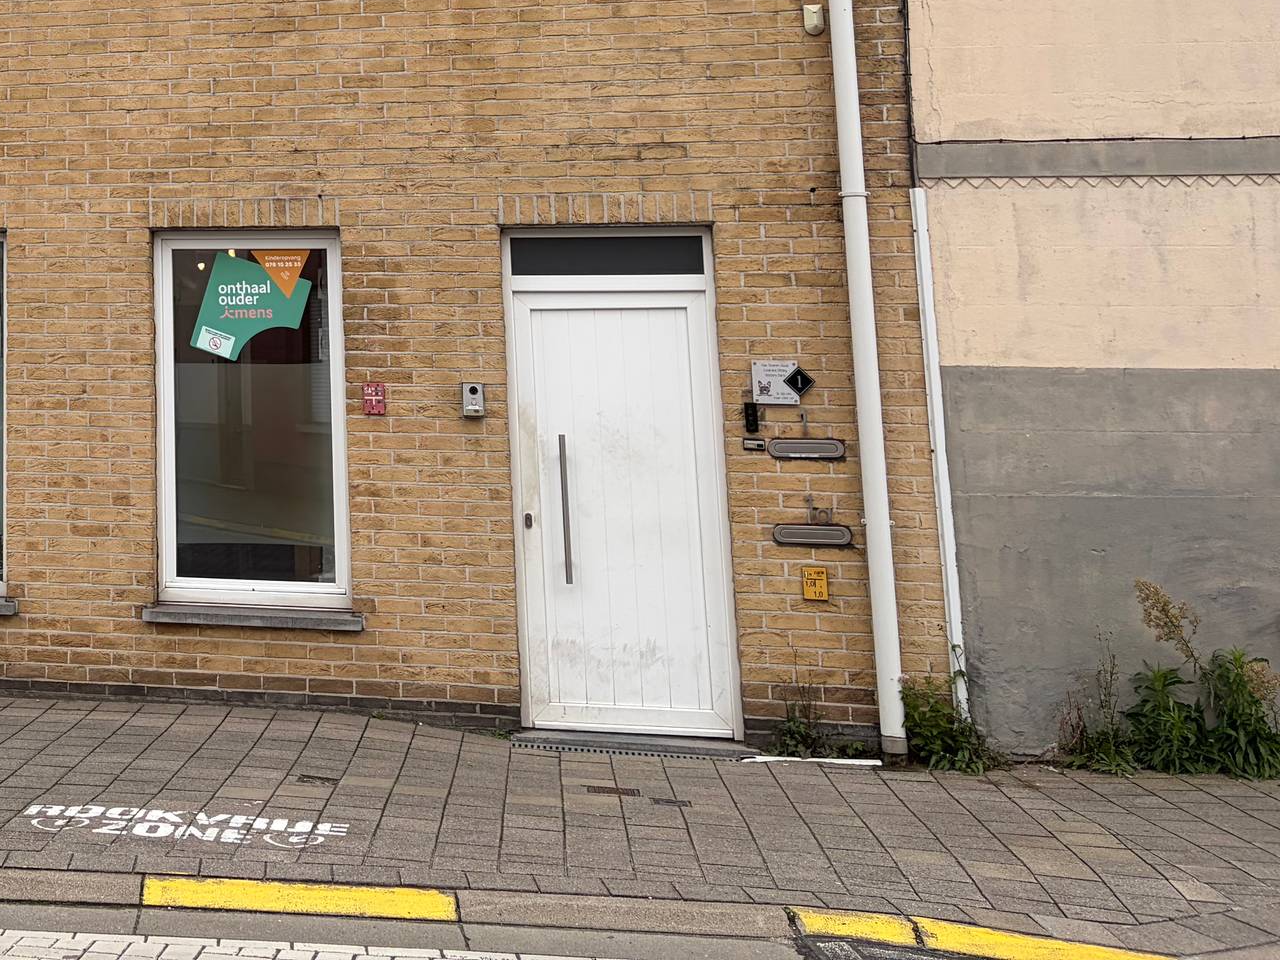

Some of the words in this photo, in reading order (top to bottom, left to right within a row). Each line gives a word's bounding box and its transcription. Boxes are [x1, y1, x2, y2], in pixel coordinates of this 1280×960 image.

[218, 280, 270, 294] onthaal
[218, 292, 259, 305] ouder
[797, 375, 803, 388] 1
[91, 821, 253, 844] ZONE
